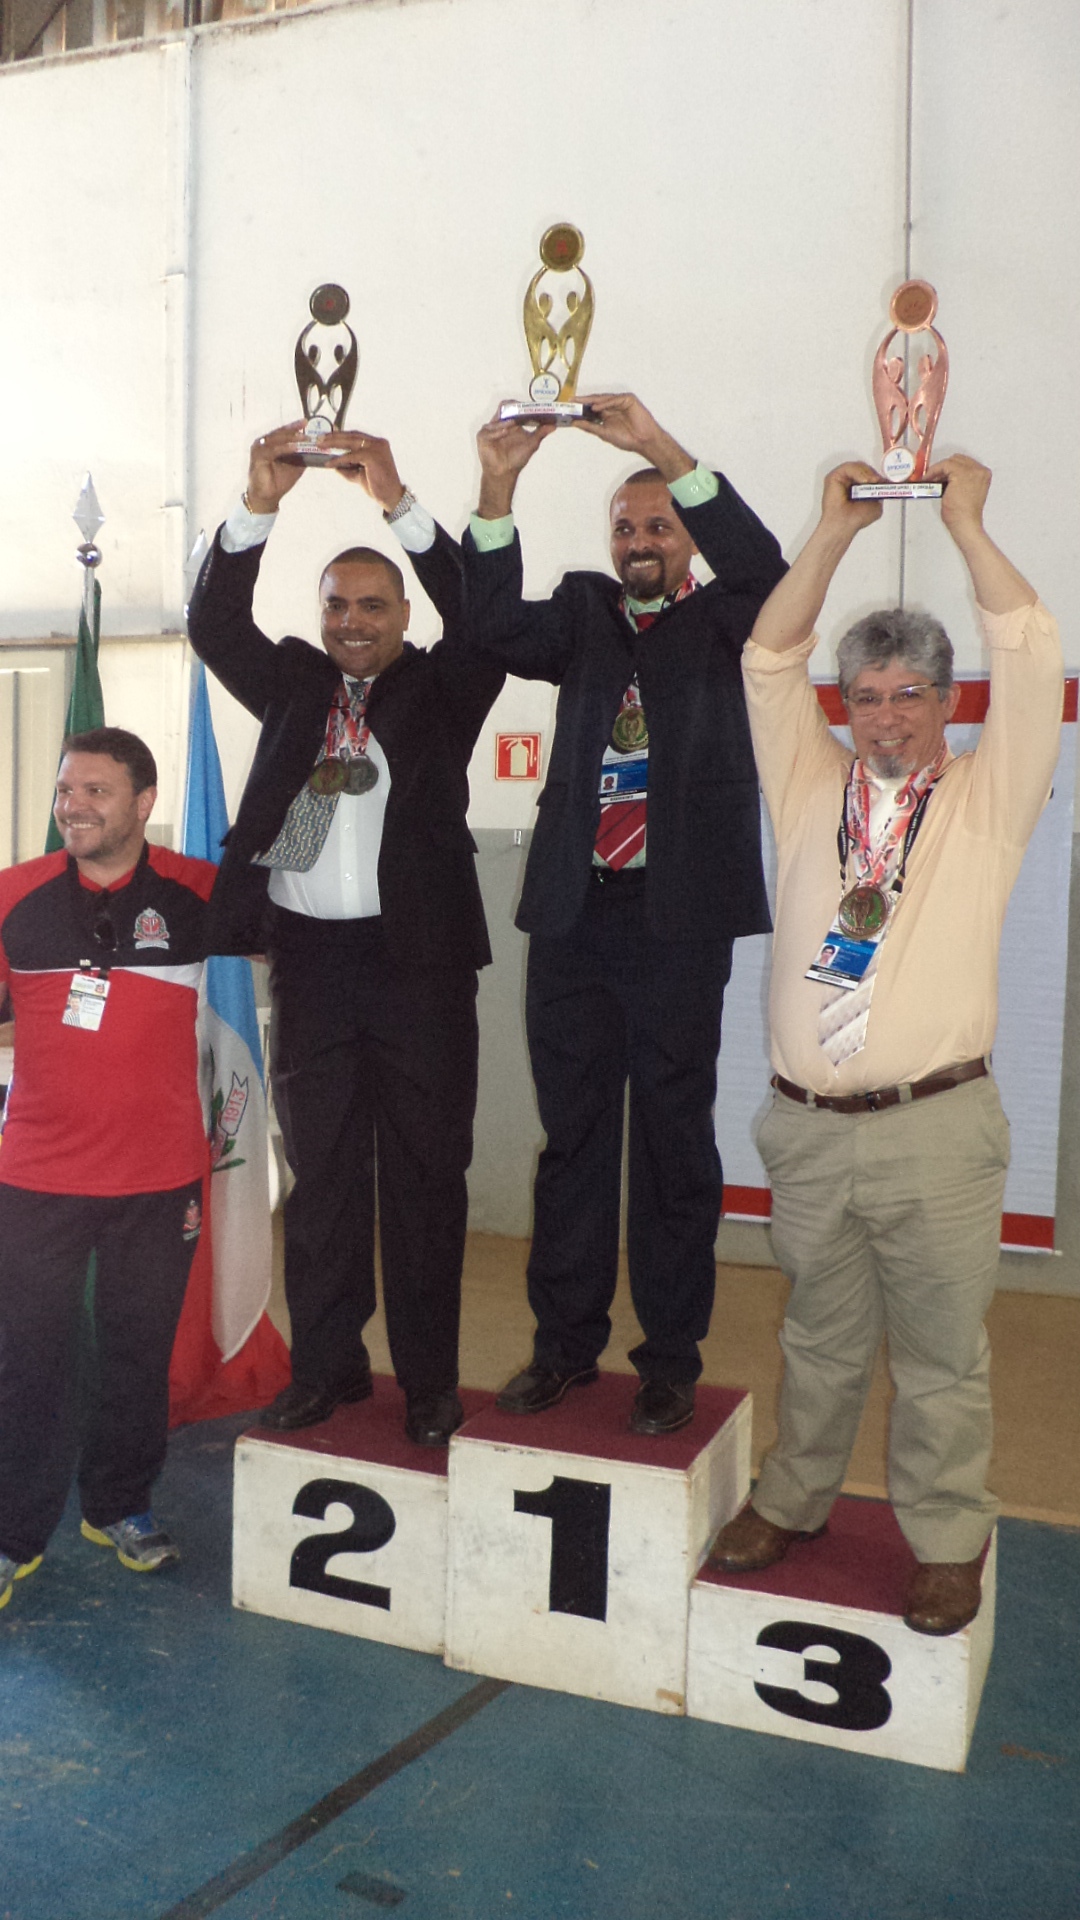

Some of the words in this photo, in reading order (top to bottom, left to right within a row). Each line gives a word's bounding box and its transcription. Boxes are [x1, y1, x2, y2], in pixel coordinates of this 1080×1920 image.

[224, 1088, 246, 1123] 1913
[289, 1477, 397, 1612] 2
[513, 1475, 611, 1623] 1
[753, 1620, 892, 1731] 3
